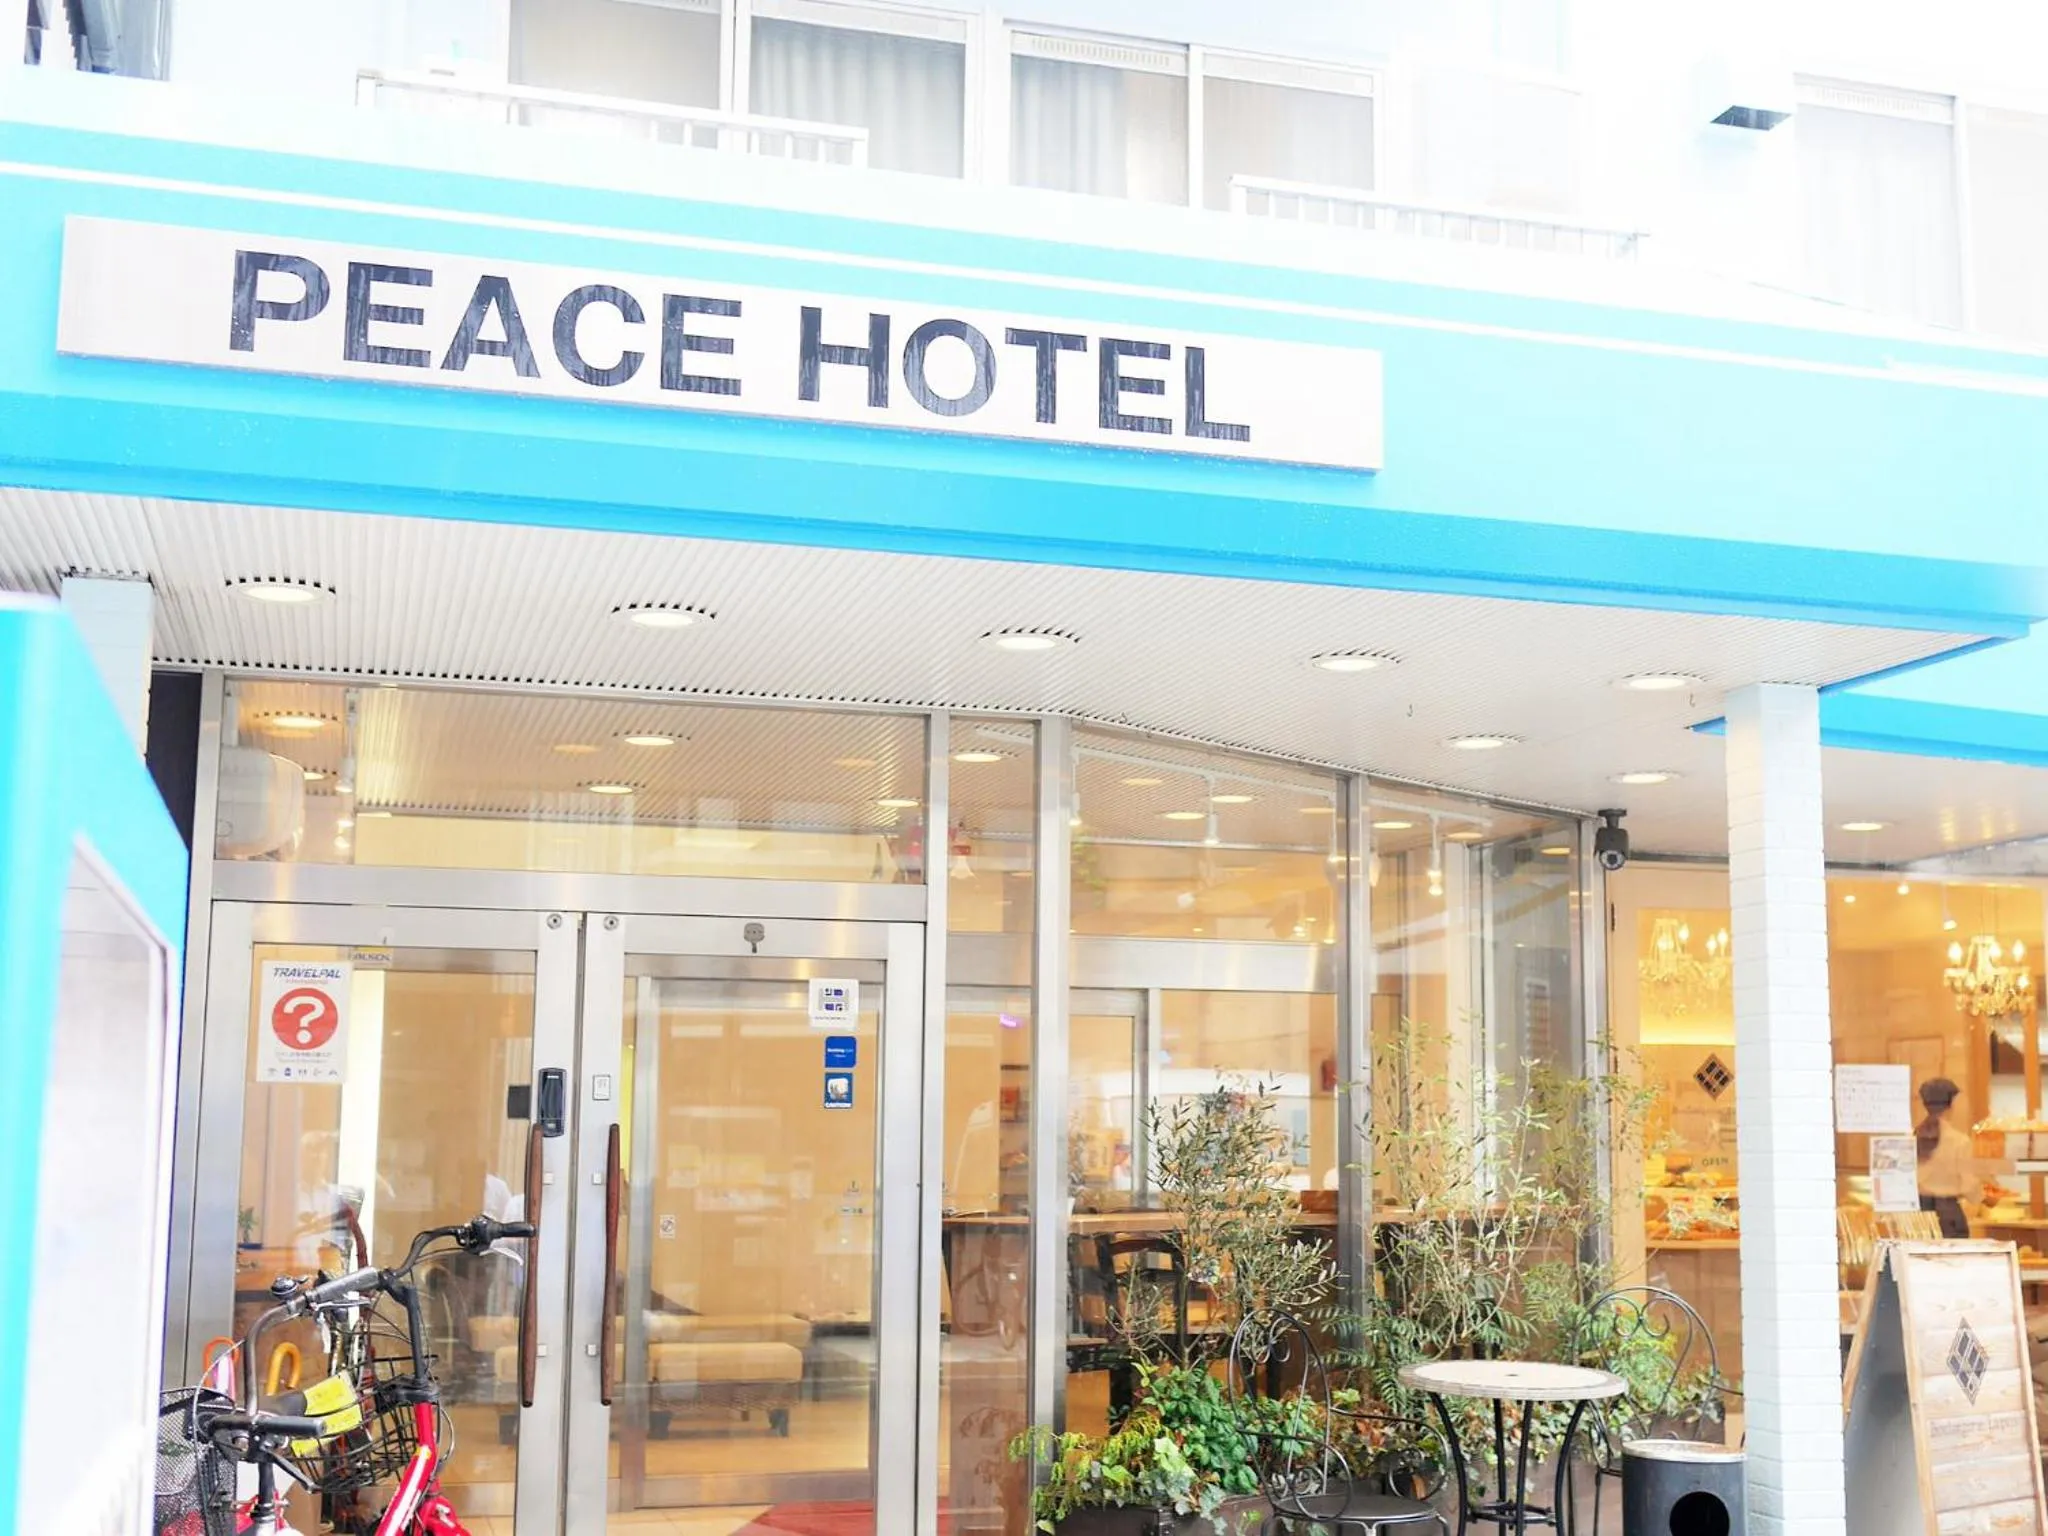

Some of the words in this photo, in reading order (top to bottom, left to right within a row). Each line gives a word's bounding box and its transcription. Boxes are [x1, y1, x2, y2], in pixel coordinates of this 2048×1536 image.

[230, 250, 742, 396] PEACE
[798, 305, 1250, 442] HOTEL
[273, 967, 341, 978] TRAVELPAL
